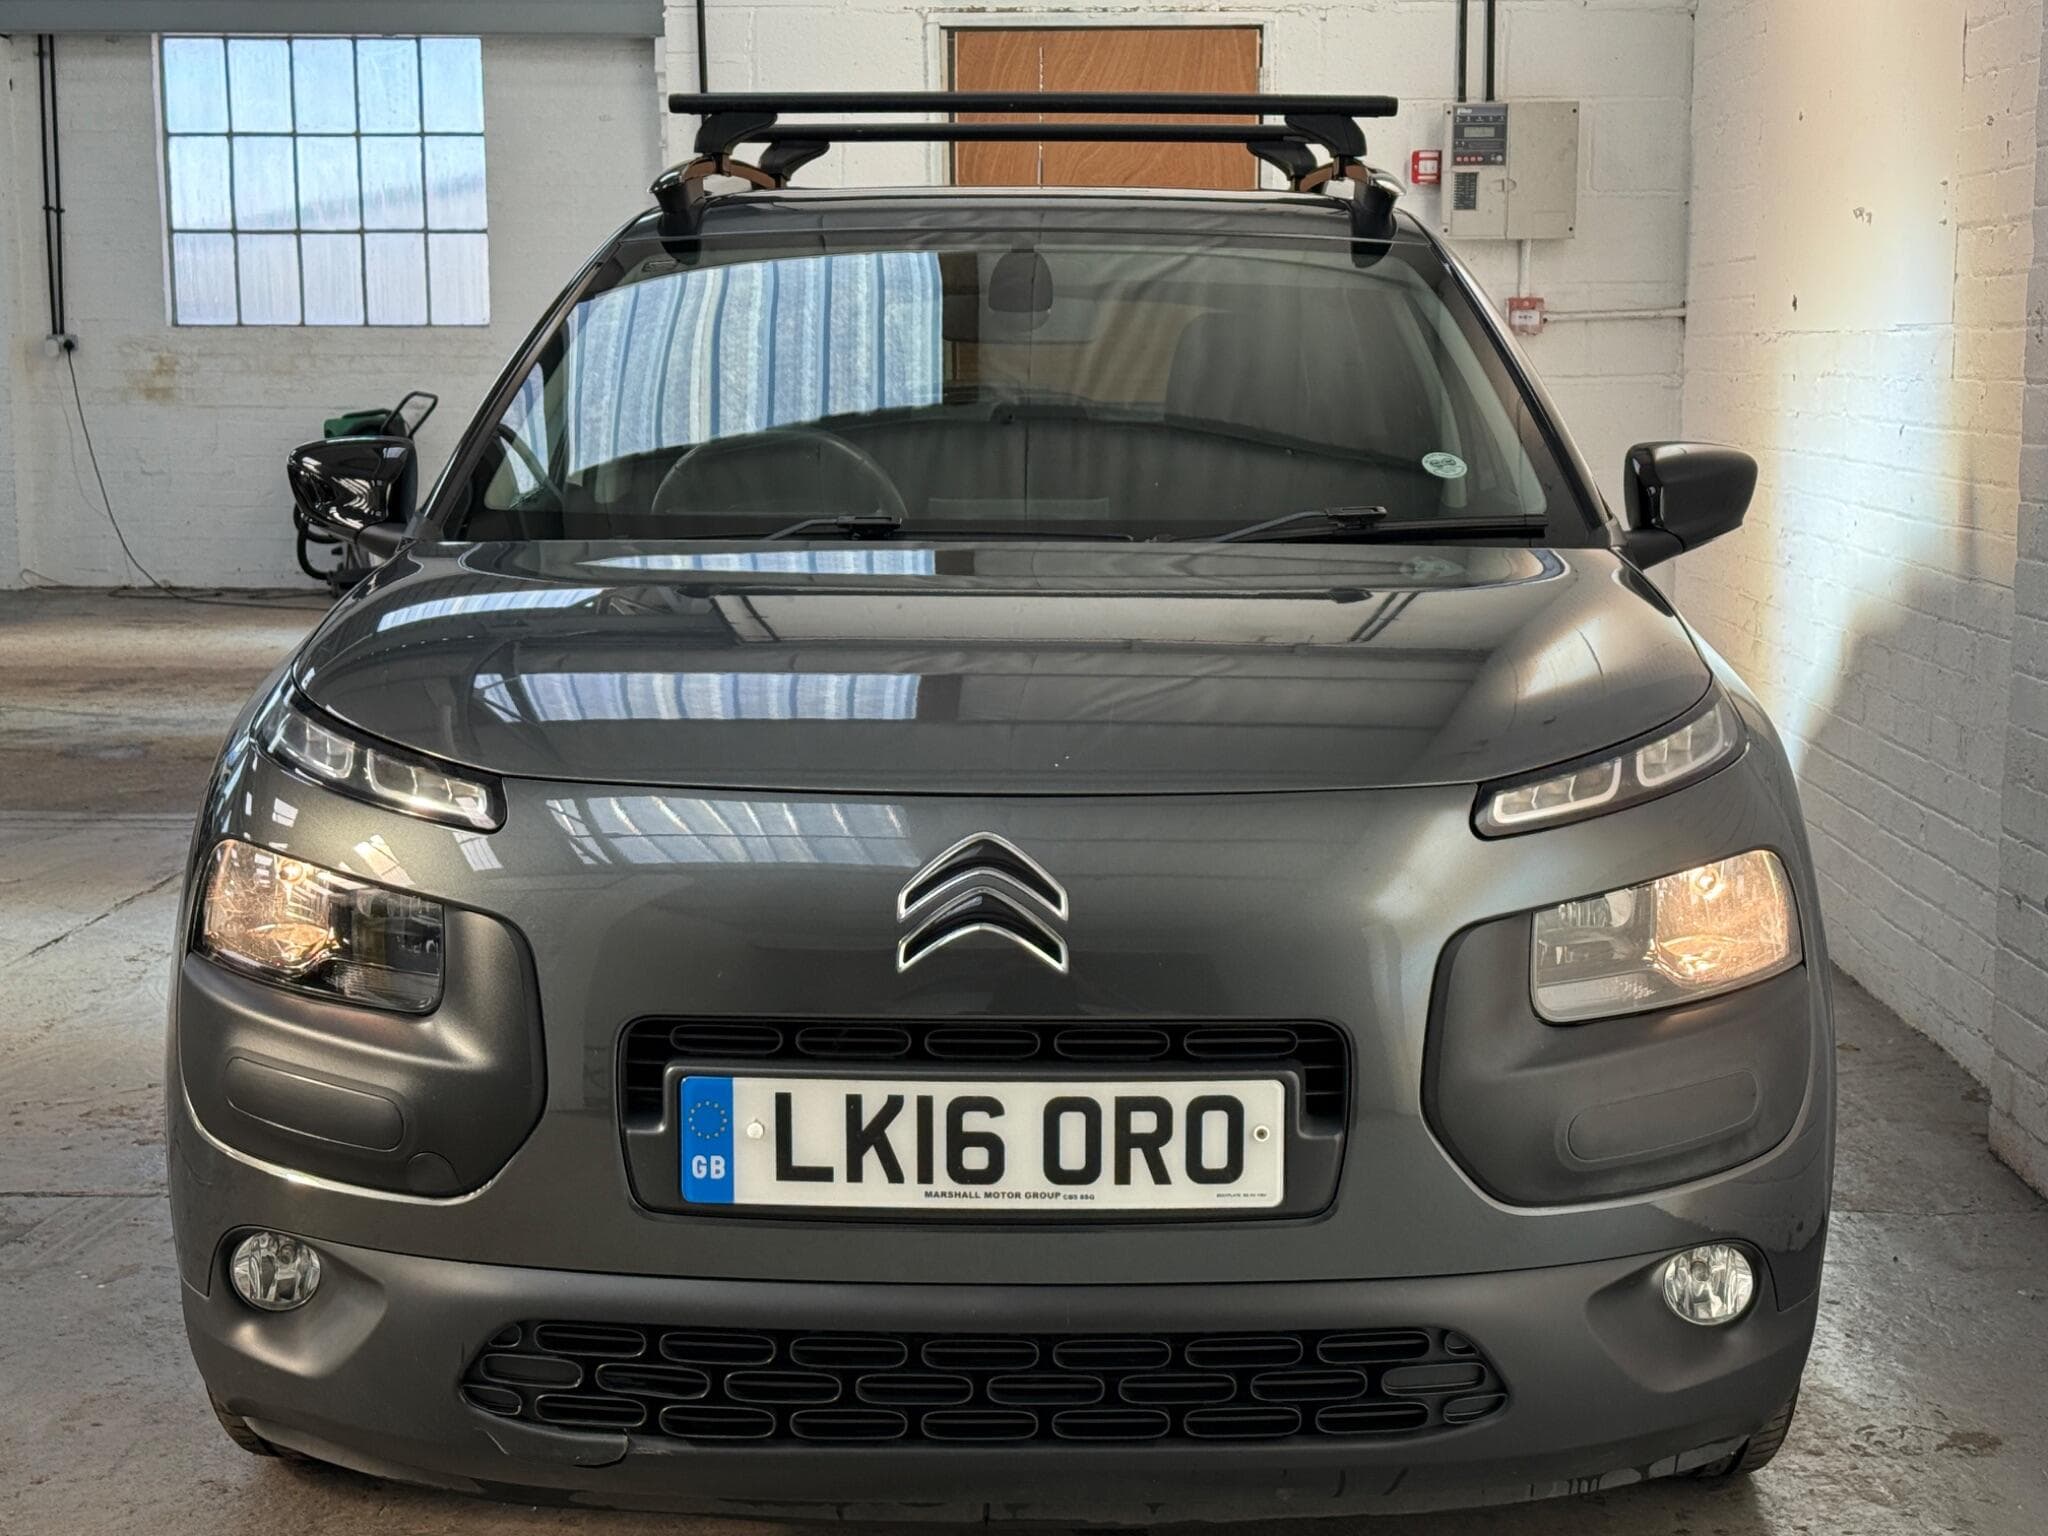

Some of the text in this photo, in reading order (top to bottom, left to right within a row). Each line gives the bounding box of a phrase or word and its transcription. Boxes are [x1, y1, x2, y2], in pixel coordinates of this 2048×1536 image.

[774, 1093, 1245, 1186] LK16 ORO
[692, 1155, 725, 1179] GB
[924, 1190, 981, 1199] MARSHALL
[983, 1191, 1022, 1199] MOTOR
[1024, 1191, 1061, 1200] GROUP
